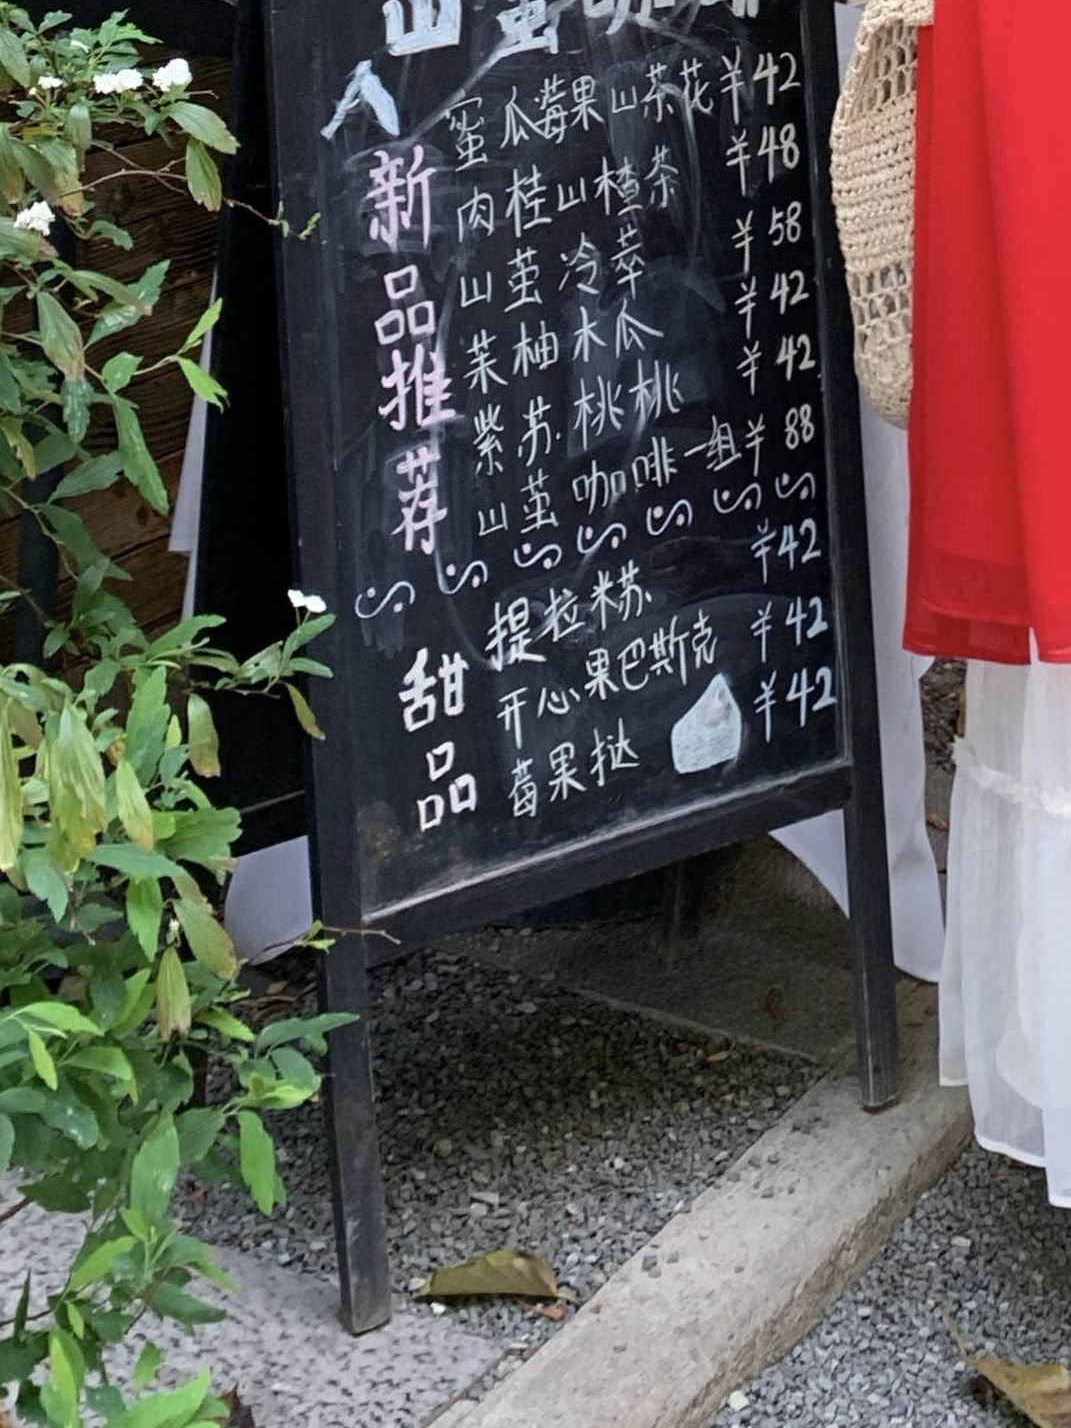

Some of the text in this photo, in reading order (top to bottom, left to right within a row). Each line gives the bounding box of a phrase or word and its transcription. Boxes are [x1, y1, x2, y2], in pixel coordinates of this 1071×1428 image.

[457, 144, 680, 243] 肉桂山楂茶
[366, 144, 456, 555] 新品推荐
[484, 559, 653, 672] 提拉米苏
[496, 608, 718, 750] 开心果巴斯克
[398, 647, 477, 834] 甜品
[508, 718, 640, 818] 莓果挞
